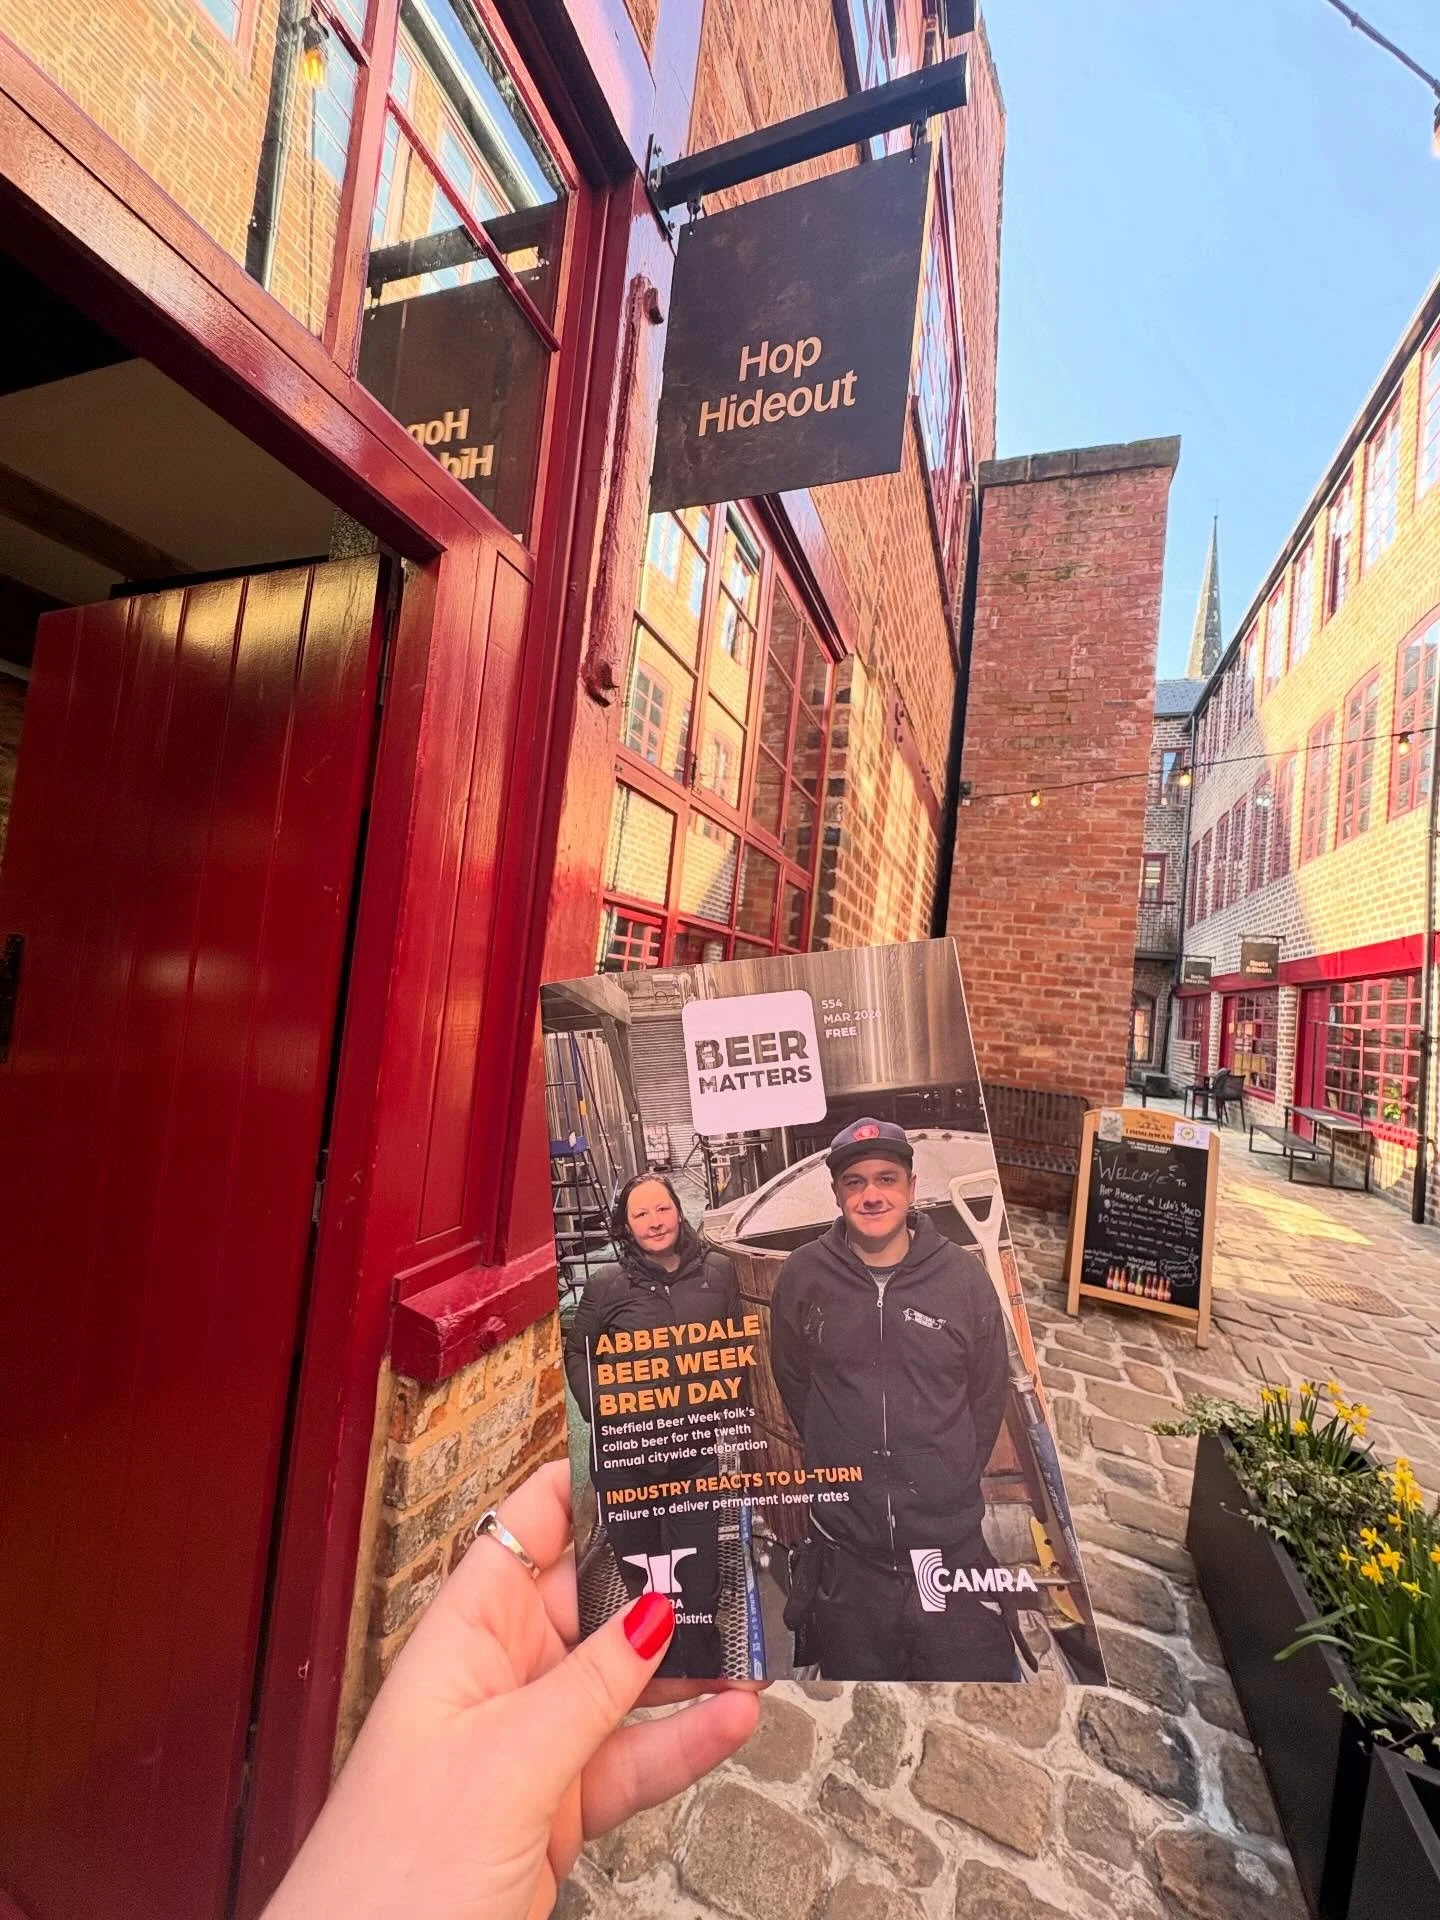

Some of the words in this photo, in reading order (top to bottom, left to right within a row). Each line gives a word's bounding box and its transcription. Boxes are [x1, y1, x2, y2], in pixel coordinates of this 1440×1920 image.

[739, 336, 823, 382] Hop
[699, 369, 858, 437] Hideout
[821, 999, 843, 1009] 554
[823, 1012, 851, 1024] MAR
[853, 1010, 882, 1021] 2026
[825, 1026, 857, 1039] FREE
[694, 1030, 809, 1071] BEER
[699, 1064, 812, 1095] MATTERS
[595, 1314, 761, 1355] ABBEYDALE
[597, 1357, 670, 1386] BEER
[675, 1344, 757, 1374] WEEK
[599, 1385, 681, 1416] BREW
[688, 1376, 742, 1405] DAY
[601, 1420, 653, 1436] Sheffield
[656, 1416, 685, 1429] Beer
[687, 1411, 721, 1424] Week
[723, 1407, 756, 1420] folk's
[602, 1439, 638, 1453] collab
[641, 1435, 668, 1448] beer
[671, 1432, 689, 1444] for
[691, 1428, 711, 1441] the
[714, 1423, 752, 1437] twelth
[603, 1455, 645, 1469] annual
[647, 1447, 697, 1464] citywide
[700, 1439, 768, 1456] celebration
[606, 1479, 691, 1505] INDUSTRY
[696, 1472, 763, 1492] REACTS
[766, 1471, 791, 1486] TO
[793, 1466, 863, 1485] U-TURN
[608, 1508, 650, 1523] Failure
[652, 1506, 666, 1517] to
[668, 1499, 710, 1514] deliver
[712, 1494, 779, 1511] permanent
[781, 1491, 815, 1505] lower
[817, 1490, 850, 1503] rates
[935, 1567, 1038, 1594] CAMRA
[675, 1612, 713, 1625] District
